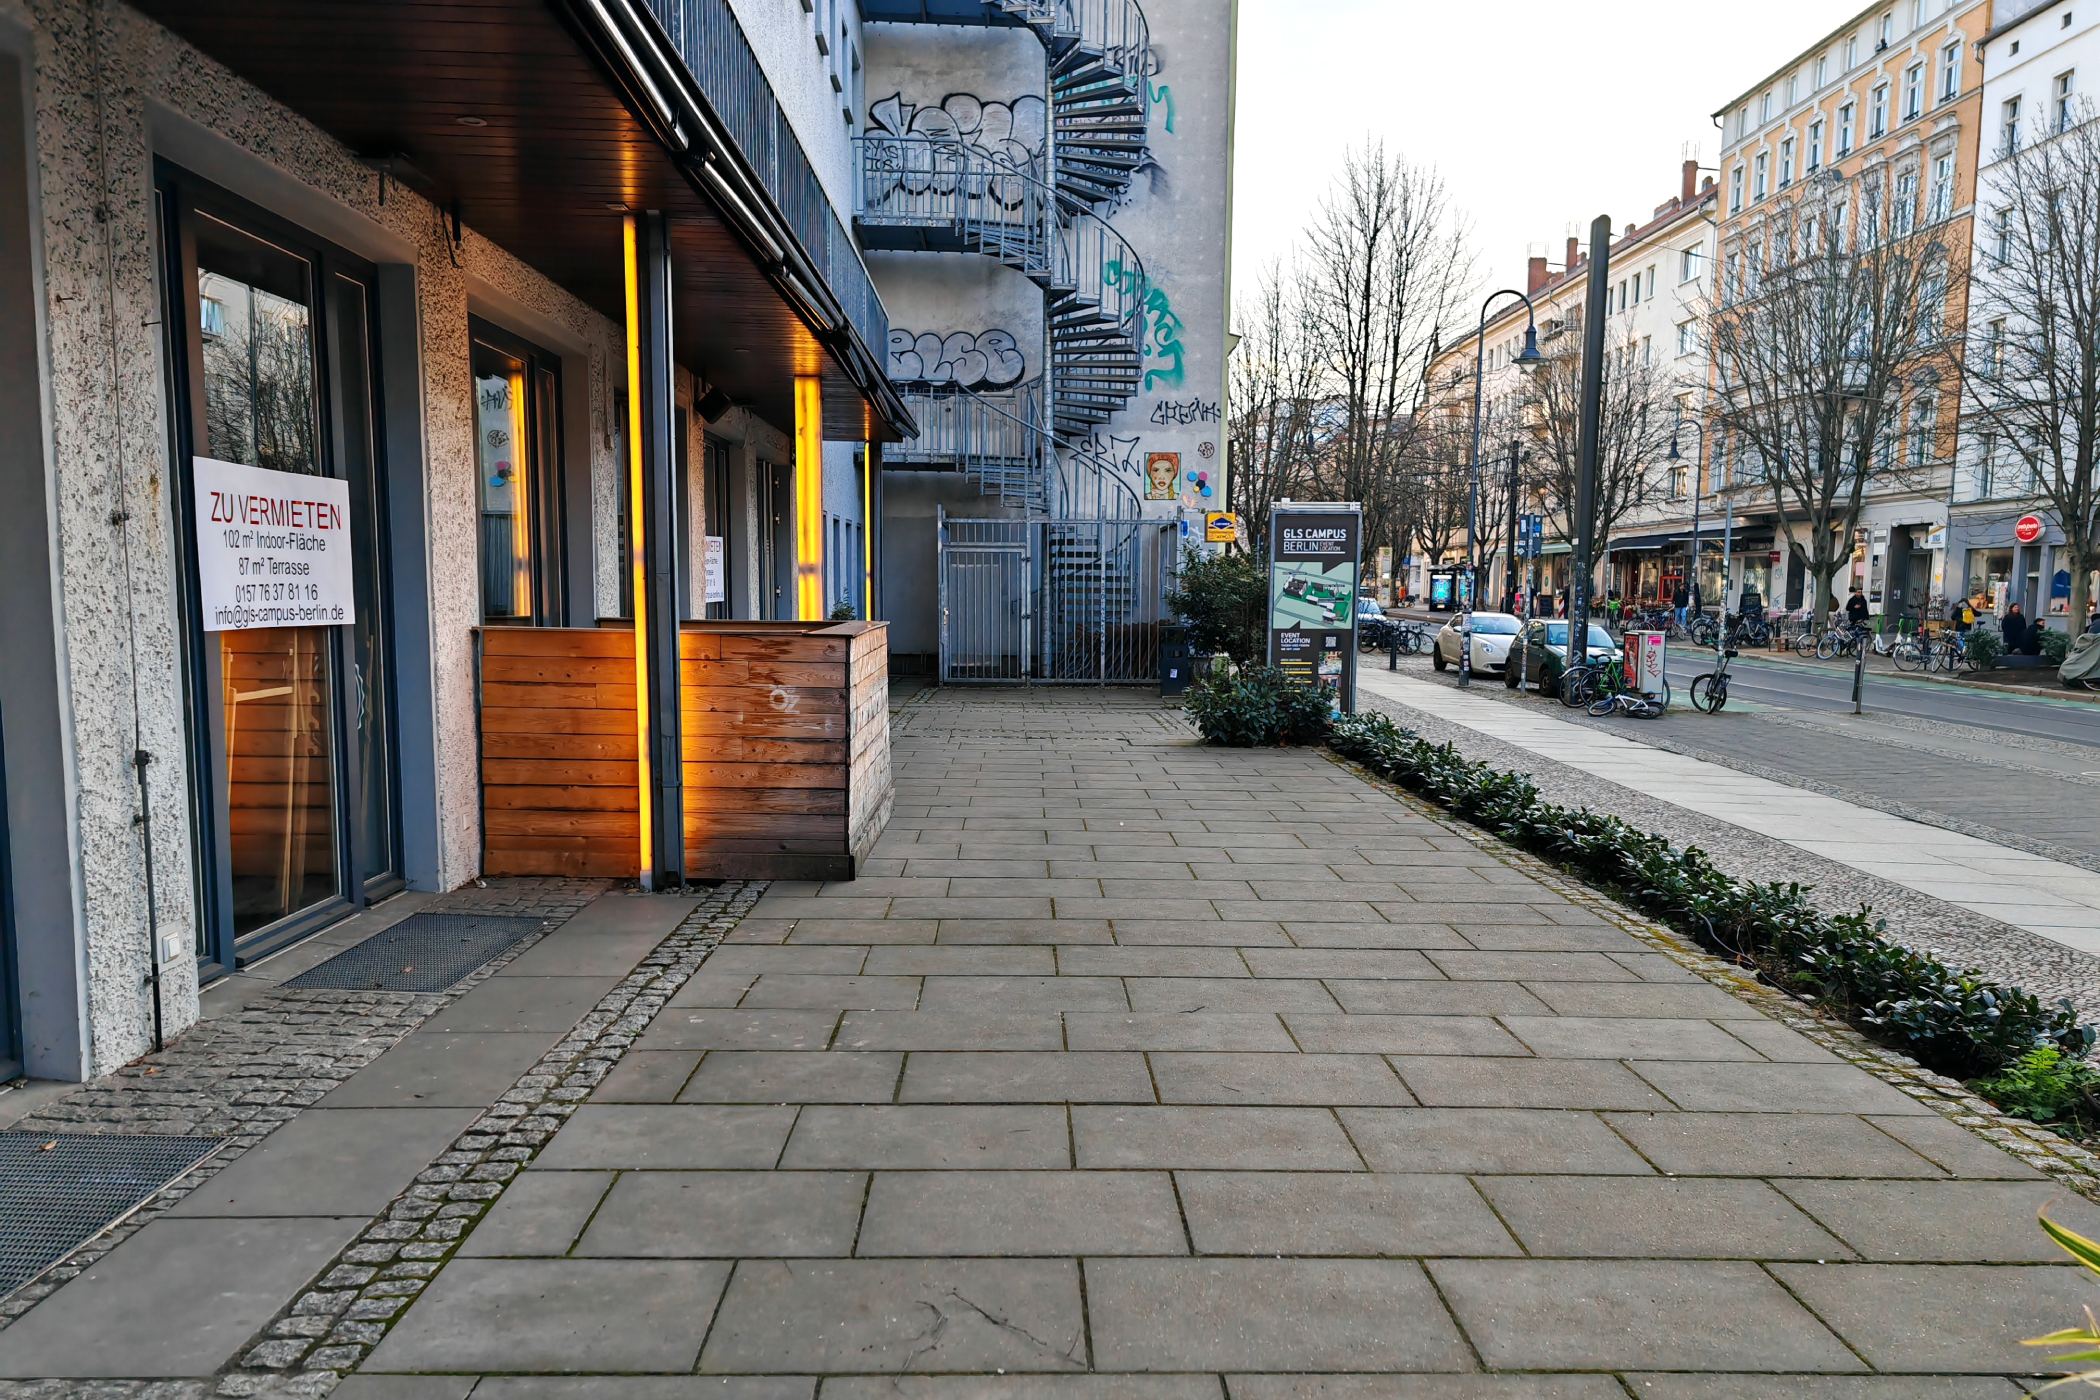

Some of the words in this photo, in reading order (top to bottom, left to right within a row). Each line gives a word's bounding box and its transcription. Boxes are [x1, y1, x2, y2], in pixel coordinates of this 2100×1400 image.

[210, 491, 234, 523] ZU
[238, 494, 342, 530] VERMIETEN
[223, 529, 240, 549] 102
[242, 531, 254, 549] m²
[256, 531, 326, 552] Indoor-Fläche
[1283, 528, 1303, 539] GLS
[1305, 528, 1347, 539] CAMPUS
[1283, 541, 1319, 551] BERLIN
[238, 557, 250, 576] 87
[252, 557, 265, 576] m²
[267, 557, 310, 576] Terrasse
[235, 584, 256, 603] 0157
[258, 583, 270, 601] 76
[272, 583, 285, 601] 37
[288, 583, 300, 601] 81
[305, 583, 318, 601] 16
[215, 603, 344, 629] info@gls-campus-berlin.de
